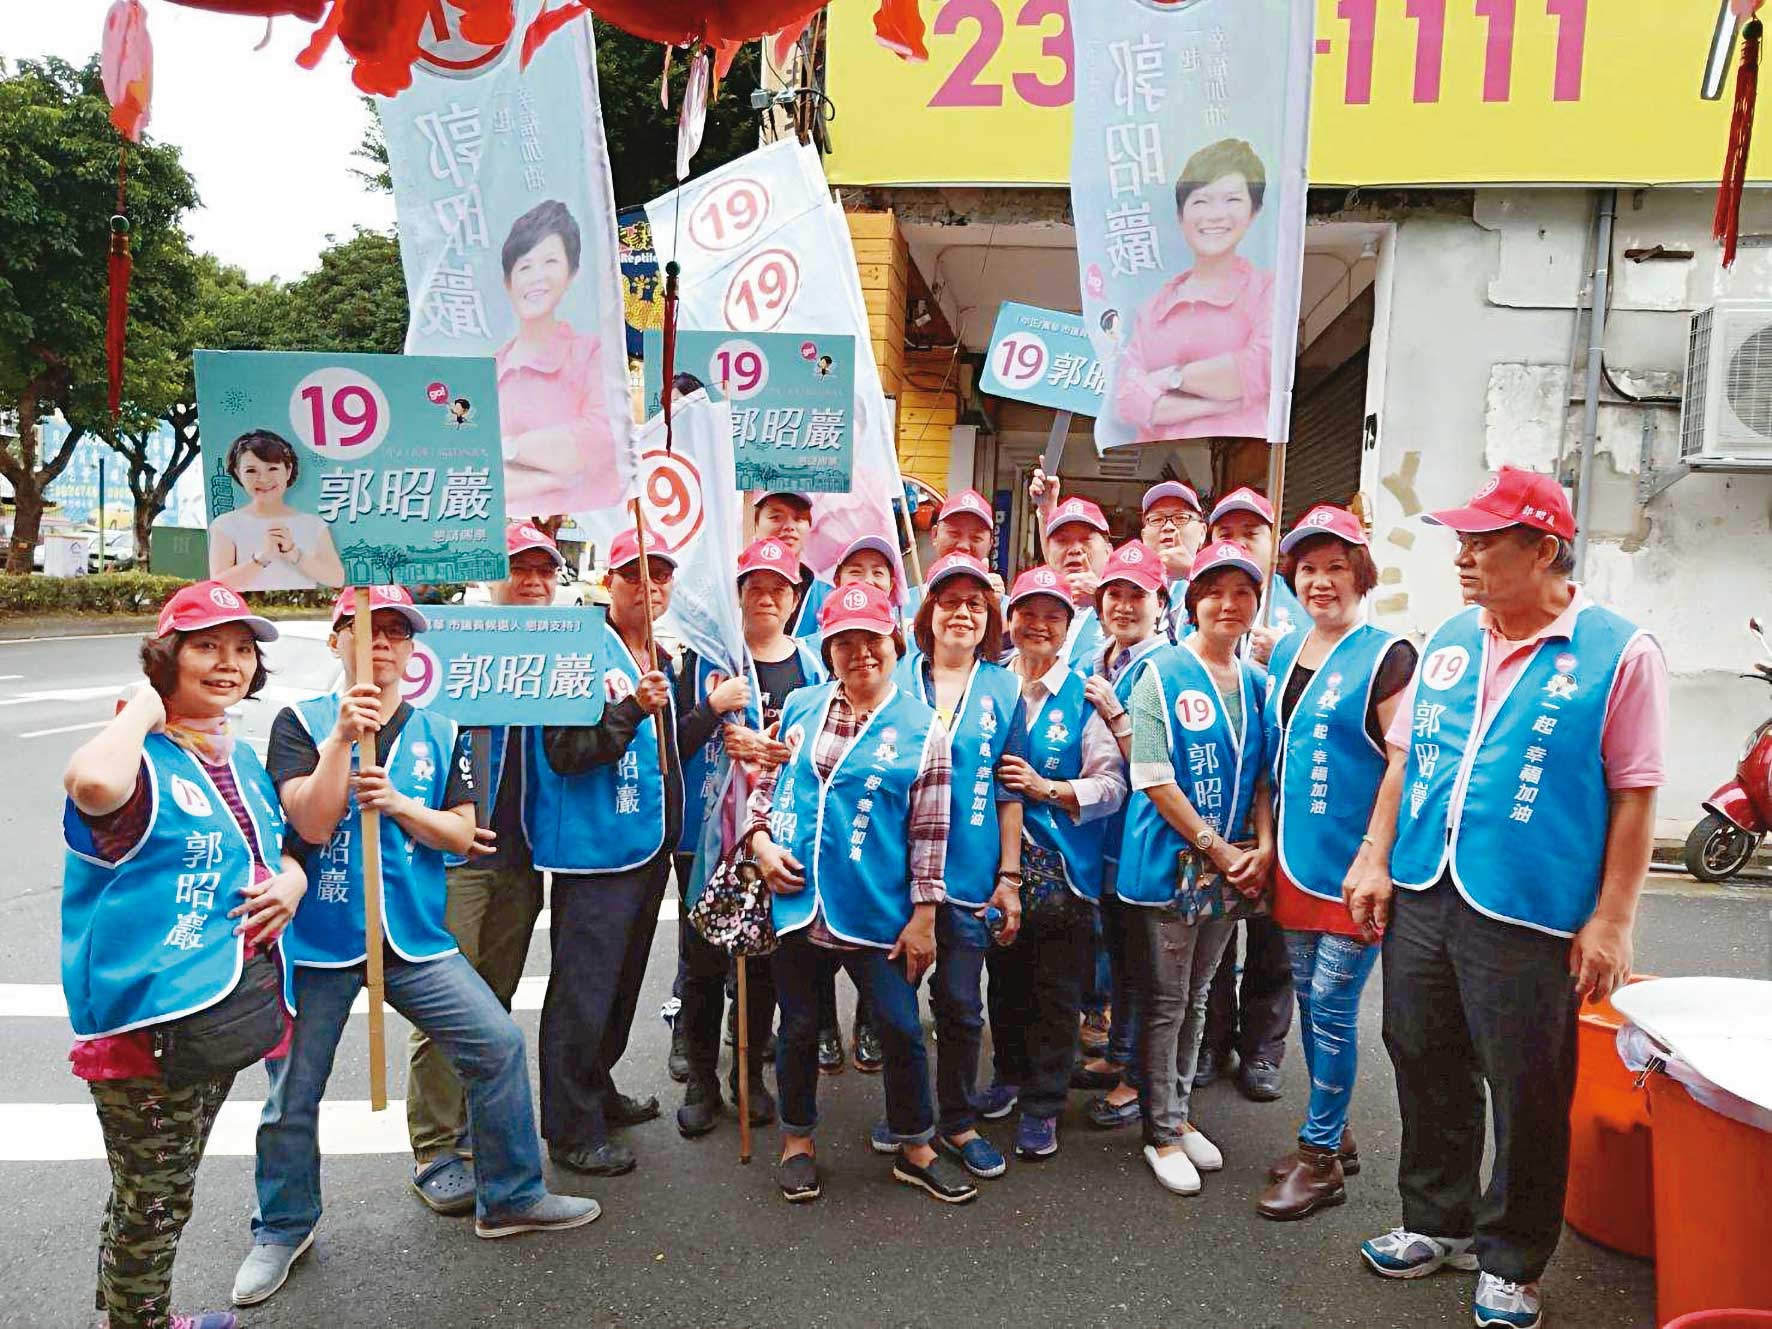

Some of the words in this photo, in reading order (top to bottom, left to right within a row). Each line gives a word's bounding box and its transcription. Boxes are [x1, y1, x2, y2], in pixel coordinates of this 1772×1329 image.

[699, 189, 759, 240] 19
[734, 261, 789, 323] 19
[716, 351, 762, 392] 19
[1001, 340, 1044, 380] 19
[301, 385, 378, 447] 19
[731, 405, 846, 451] 郭昭巖
[317, 466, 493, 523] 郭昭巖
[445, 652, 597, 700] 郭昭巖
[1428, 652, 1464, 682] 19
[1178, 697, 1211, 724] 19
[317, 806, 352, 903] 昭巖
[163, 830, 224, 950] 郭昭巖
